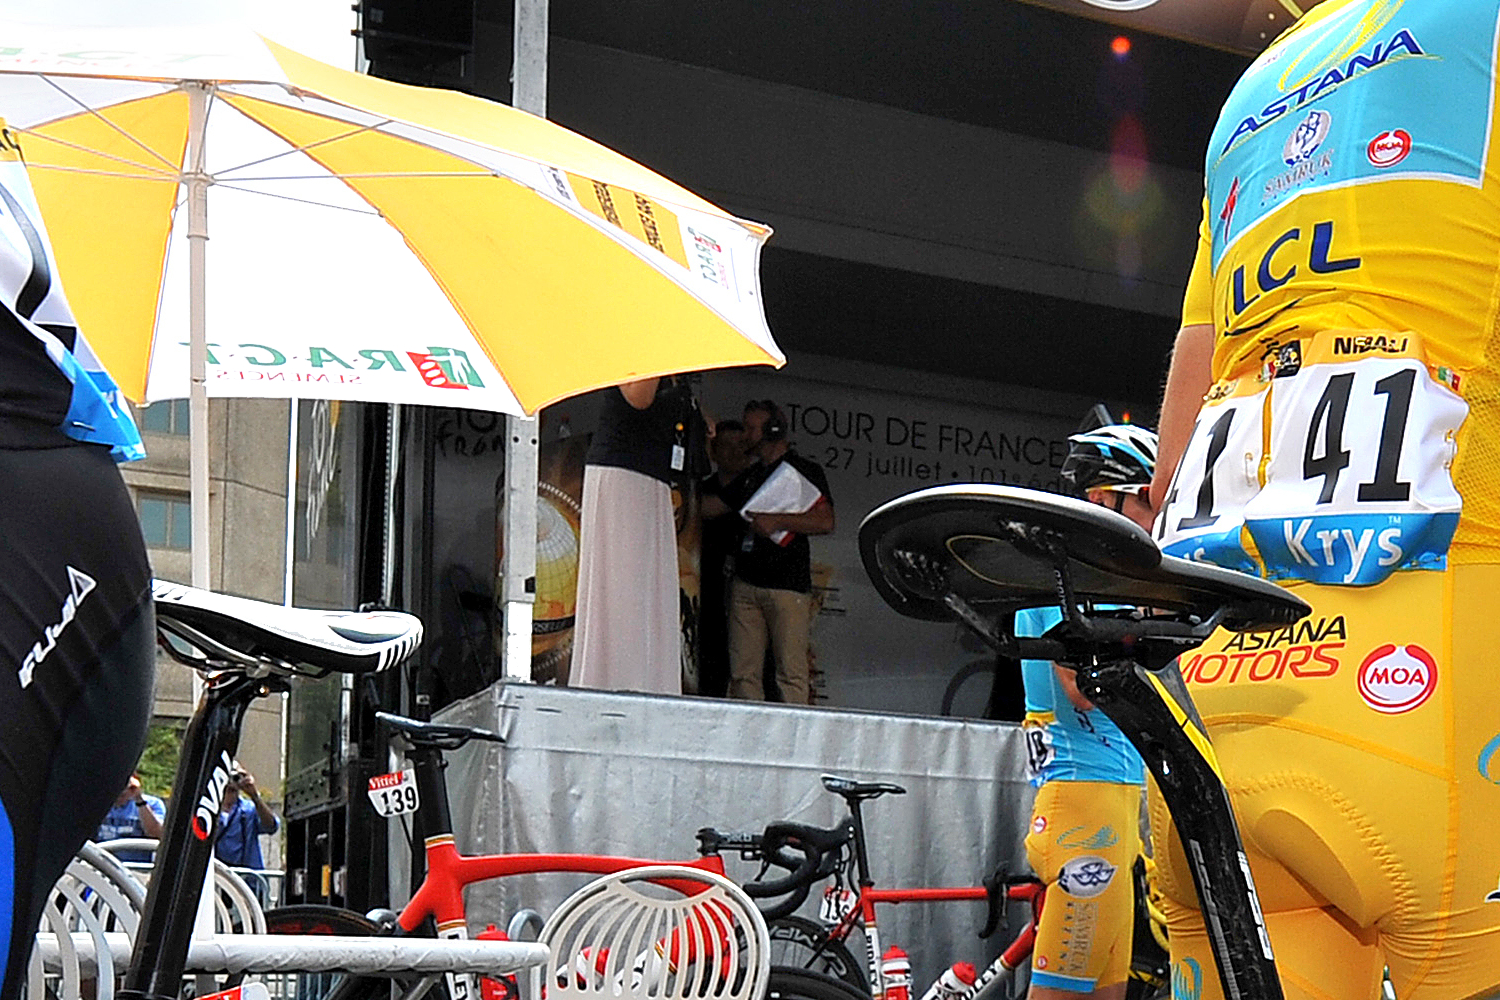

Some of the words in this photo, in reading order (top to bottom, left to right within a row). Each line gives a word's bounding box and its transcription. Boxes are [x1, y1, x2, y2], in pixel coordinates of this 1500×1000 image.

[1221, 28, 1425, 156] ASTANA
[1231, 221, 1361, 316] LCL
[786, 403, 875, 442] TOUR
[886, 417, 927, 450] DE
[938, 425, 1067, 469] FRANCE
[1304, 369, 1417, 504] 41
[824, 446, 855, 471] 27
[866, 452, 941, 482] juillet
[1283, 518, 1403, 584] Krys
[1221, 616, 1347, 652] ASTANA
[1369, 667, 1425, 686] MOA
[368, 773, 400, 790] Vittel
[381, 785, 417, 817] 139
[865, 934, 881, 989] RIDLEY
